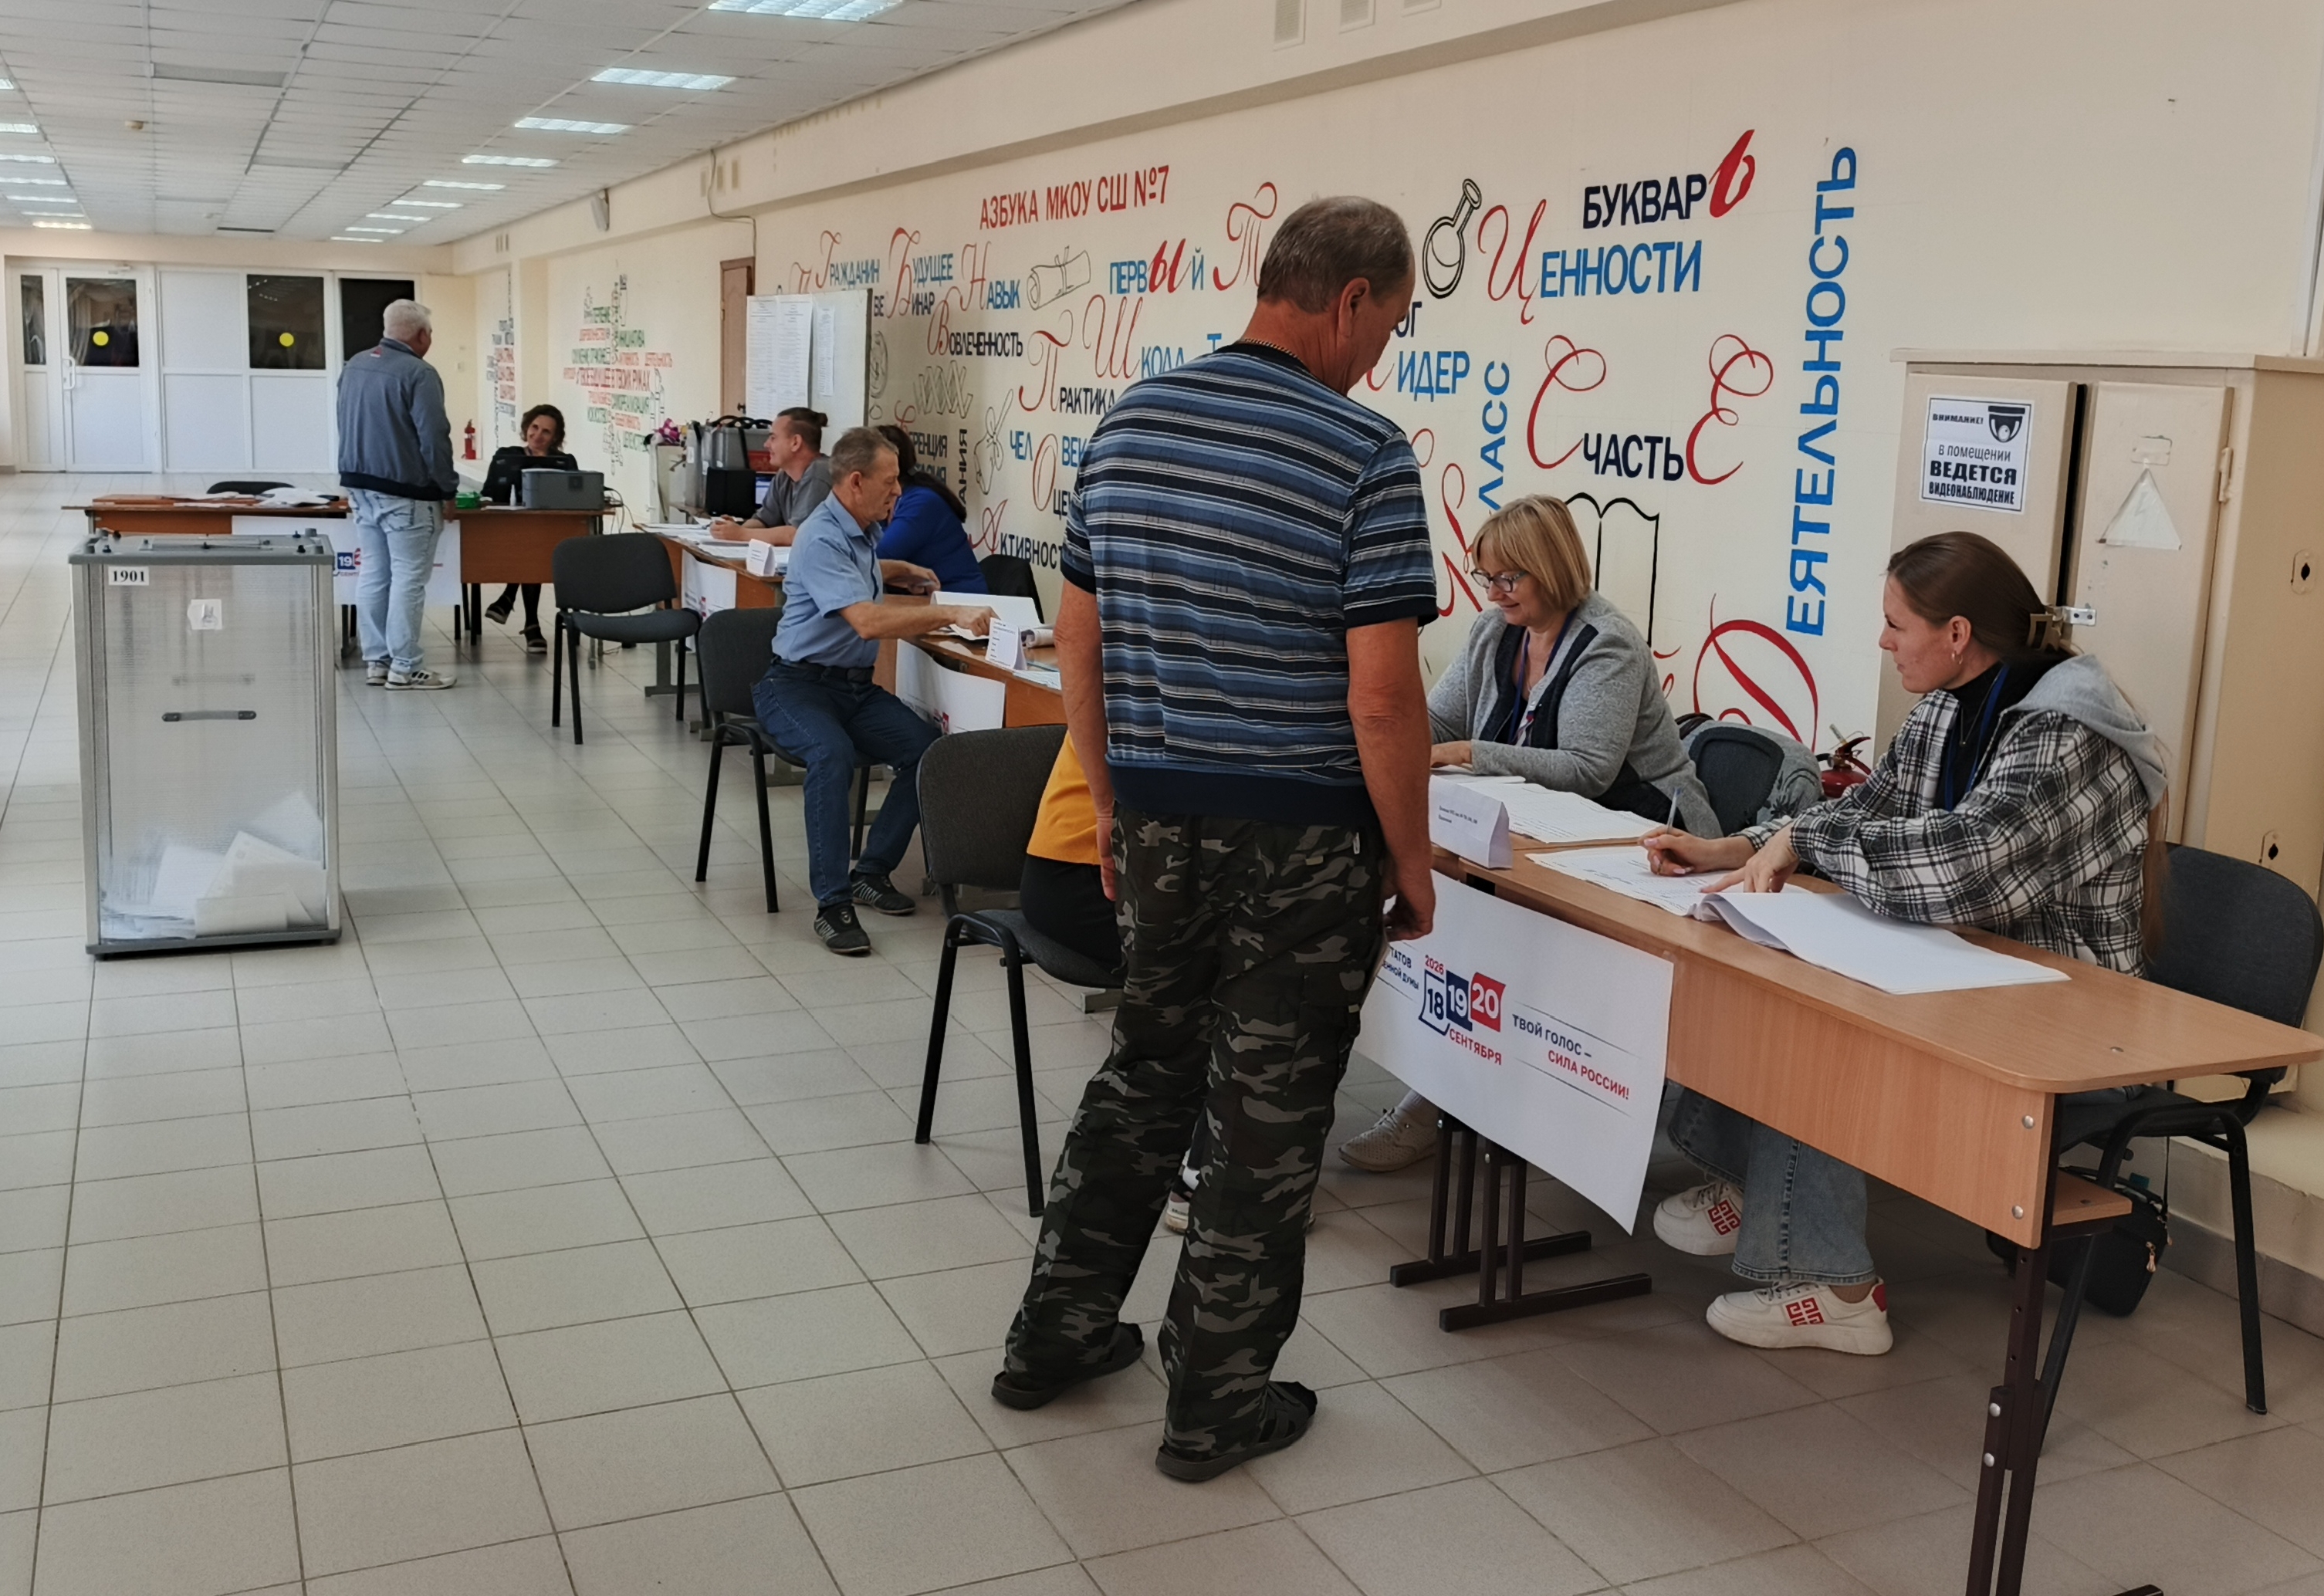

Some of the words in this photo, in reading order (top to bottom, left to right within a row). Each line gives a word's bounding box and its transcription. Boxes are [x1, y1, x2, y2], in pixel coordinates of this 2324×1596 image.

[979, 189, 1039, 230] АЗБУКА
[1046, 179, 1091, 221] МКОУ
[1098, 174, 1127, 212] СШ
[1134, 164, 1169, 207] №7
[887, 227, 953, 319] БУДУЩЕЕ
[960, 241, 1020, 311] НАВЫК
[1109, 238, 1204, 295] ПЕРВЫЙ
[1477, 198, 1702, 324] ЦЕННОСТИ
[927, 286, 1023, 357] ВОВЛЕЧЕННОСТЬ
[1932, 413, 1984, 424] ВНИМАНИЕ!
[1930, 460, 2017, 485] ВЕДЕТСЯ
[1929, 482, 2015, 505] ВИДЕОНАБЛЮДЕНИЕ
[113, 570, 145, 582] 1901
[339, 556, 353, 567] 19
[1425, 955, 1444, 975] 2026
[1427, 989, 1444, 1020] 18
[1448, 985, 1468, 1018] 19
[1471, 982, 1500, 1019] 20
[1450, 1028, 1502, 1066] СЕНТЯБРЯ
[1512, 1013, 1543, 1038] ТВОЙ
[1544, 1030, 1581, 1056] ГОЛОС
[1548, 1050, 1578, 1075] СИЛА
[1581, 1065, 1630, 1101] РОССИИ!
